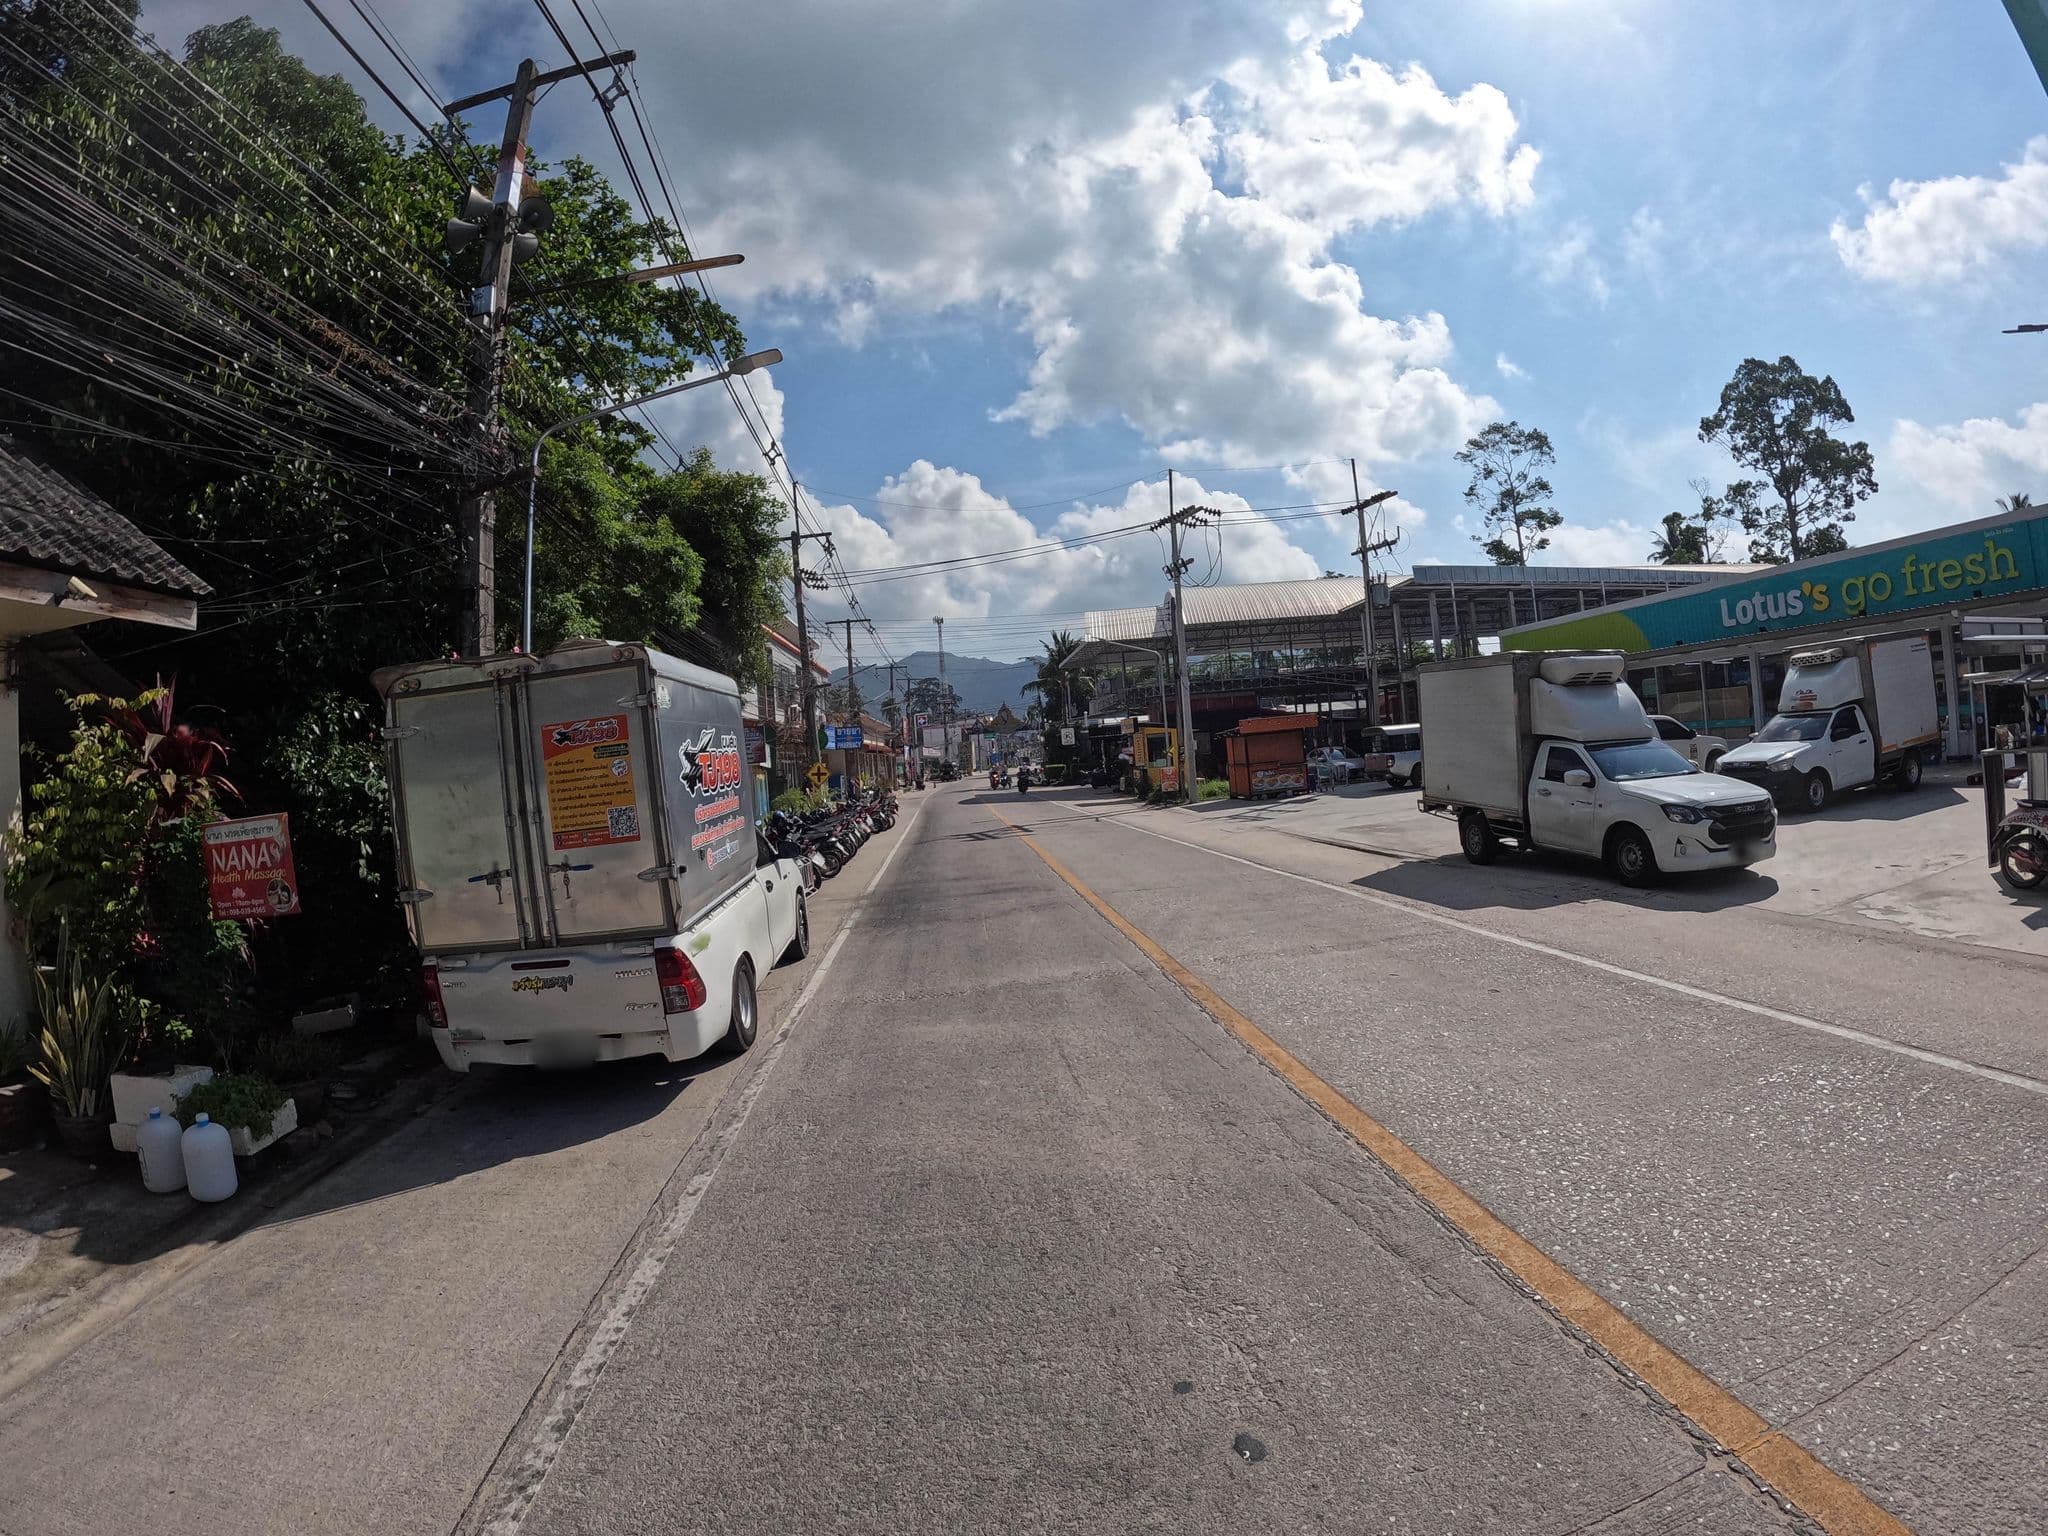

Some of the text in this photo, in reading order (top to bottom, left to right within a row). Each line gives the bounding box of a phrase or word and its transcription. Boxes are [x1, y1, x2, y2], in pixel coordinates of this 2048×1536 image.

[1720, 539, 2020, 628] Lotus's go fresh
[698, 750, 741, 792] TJ198
[212, 842, 272, 872] NANA
[212, 867, 286, 884] Health Massage
[615, 968, 653, 979] HILUX
